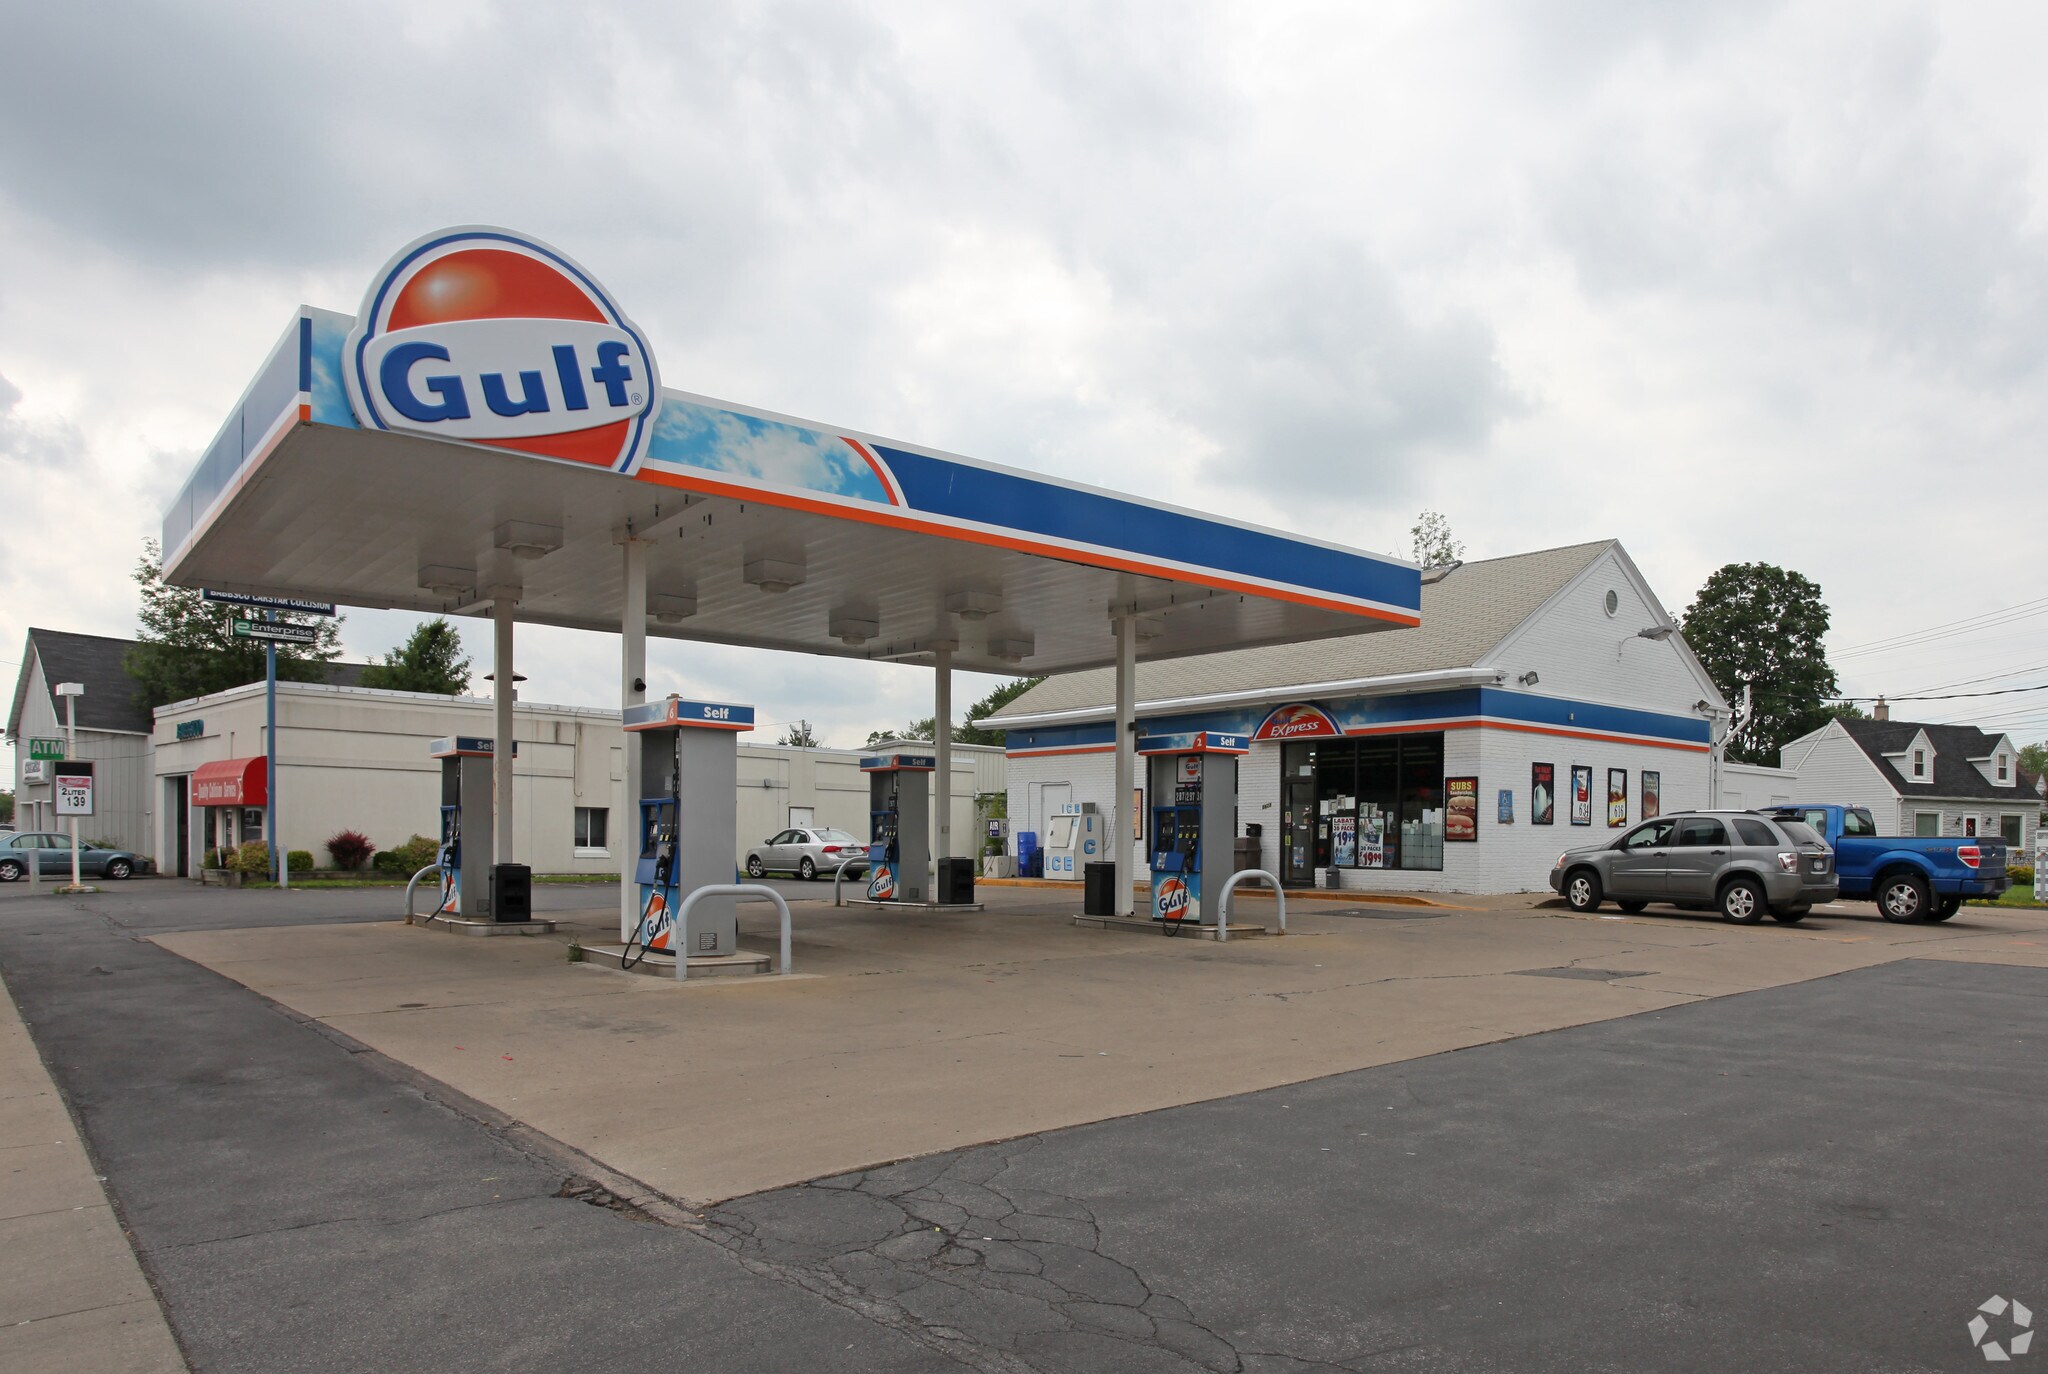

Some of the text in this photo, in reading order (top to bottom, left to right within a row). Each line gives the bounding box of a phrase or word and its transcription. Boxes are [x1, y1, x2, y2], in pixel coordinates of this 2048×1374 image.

[380, 341, 632, 422] Gulf
[251, 623, 313, 637] Enterprise
[669, 707, 674, 719] 6
[703, 706, 729, 719] Self
[31, 741, 64, 754] ATM
[477, 741, 494, 750] Sel
[1197, 738, 1203, 747] 2
[1220, 737, 1235, 747] Self
[912, 758, 926, 766] Self
[1450, 781, 1472, 790] SUBS
[1061, 804, 1080, 814] ICE
[989, 821, 999, 831] AIR
[1045, 856, 1074, 872] ICE
[875, 877, 893, 892] Gulf
[1159, 891, 1188, 911] Gulf
